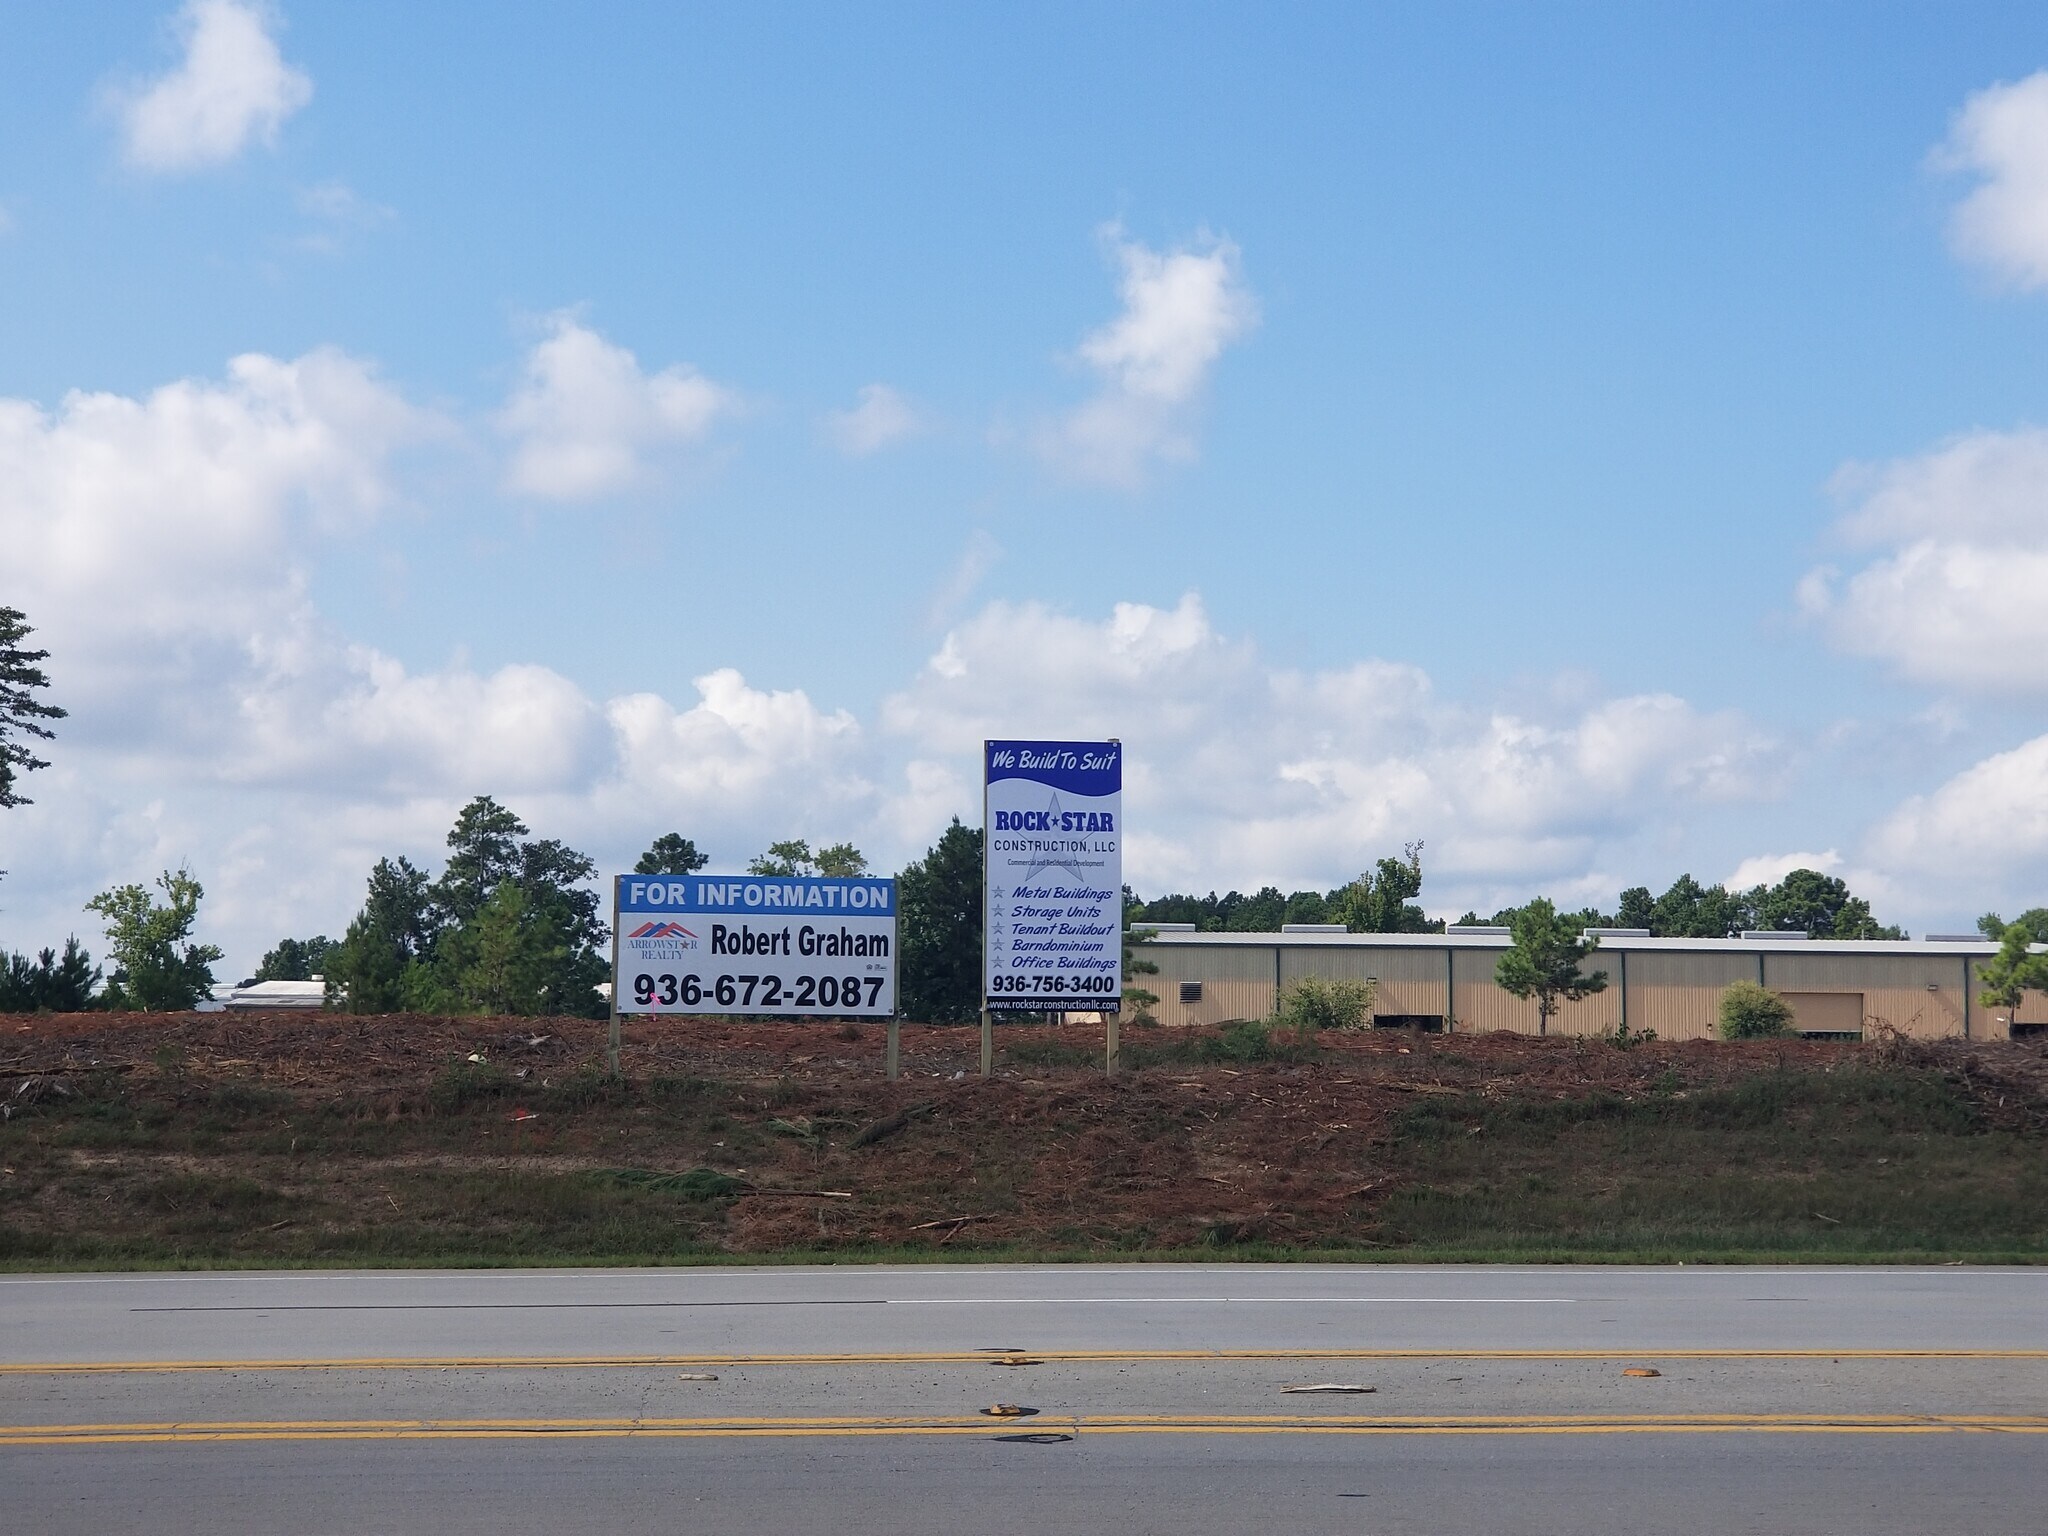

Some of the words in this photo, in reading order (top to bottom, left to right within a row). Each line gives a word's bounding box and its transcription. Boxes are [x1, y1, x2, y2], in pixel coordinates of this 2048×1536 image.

[992, 750, 1015, 768] We
[1019, 749, 1060, 769] Build
[1060, 752, 1077, 770] To
[1080, 751, 1117, 770] Suit
[995, 811, 1050, 831] ROCK
[1061, 811, 1114, 832] STAR
[994, 840, 1091, 853] CONSTRUCTION,
[1094, 841, 1116, 852] LLC
[1007, 858, 1036, 866] Commercial
[1037, 858, 1046, 866] and
[1047, 859, 1072, 867] Residential
[1073, 859, 1104, 867] Development
[630, 882, 686, 905] FOR
[697, 883, 888, 908] INFORMATION
[1012, 886, 1052, 898] Metal
[1053, 886, 1113, 903] Buildings
[1011, 905, 1063, 921] Storage
[1066, 906, 1101, 918] Units
[1011, 922, 1058, 935] Tenant
[1058, 922, 1115, 936] Buildout
[711, 924, 791, 955] Robert
[798, 925, 889, 956] Graham
[1011, 938, 1104, 952] Barndominium
[641, 950, 684, 960] REALTY
[1011, 956, 1054, 969] Office
[1057, 956, 1117, 972] Buildings
[634, 974, 884, 1007] 936-672-2087
[992, 975, 1114, 992] 936-756-3400
[989, 999, 1118, 1010] www.rockstarconstructionllc.com
